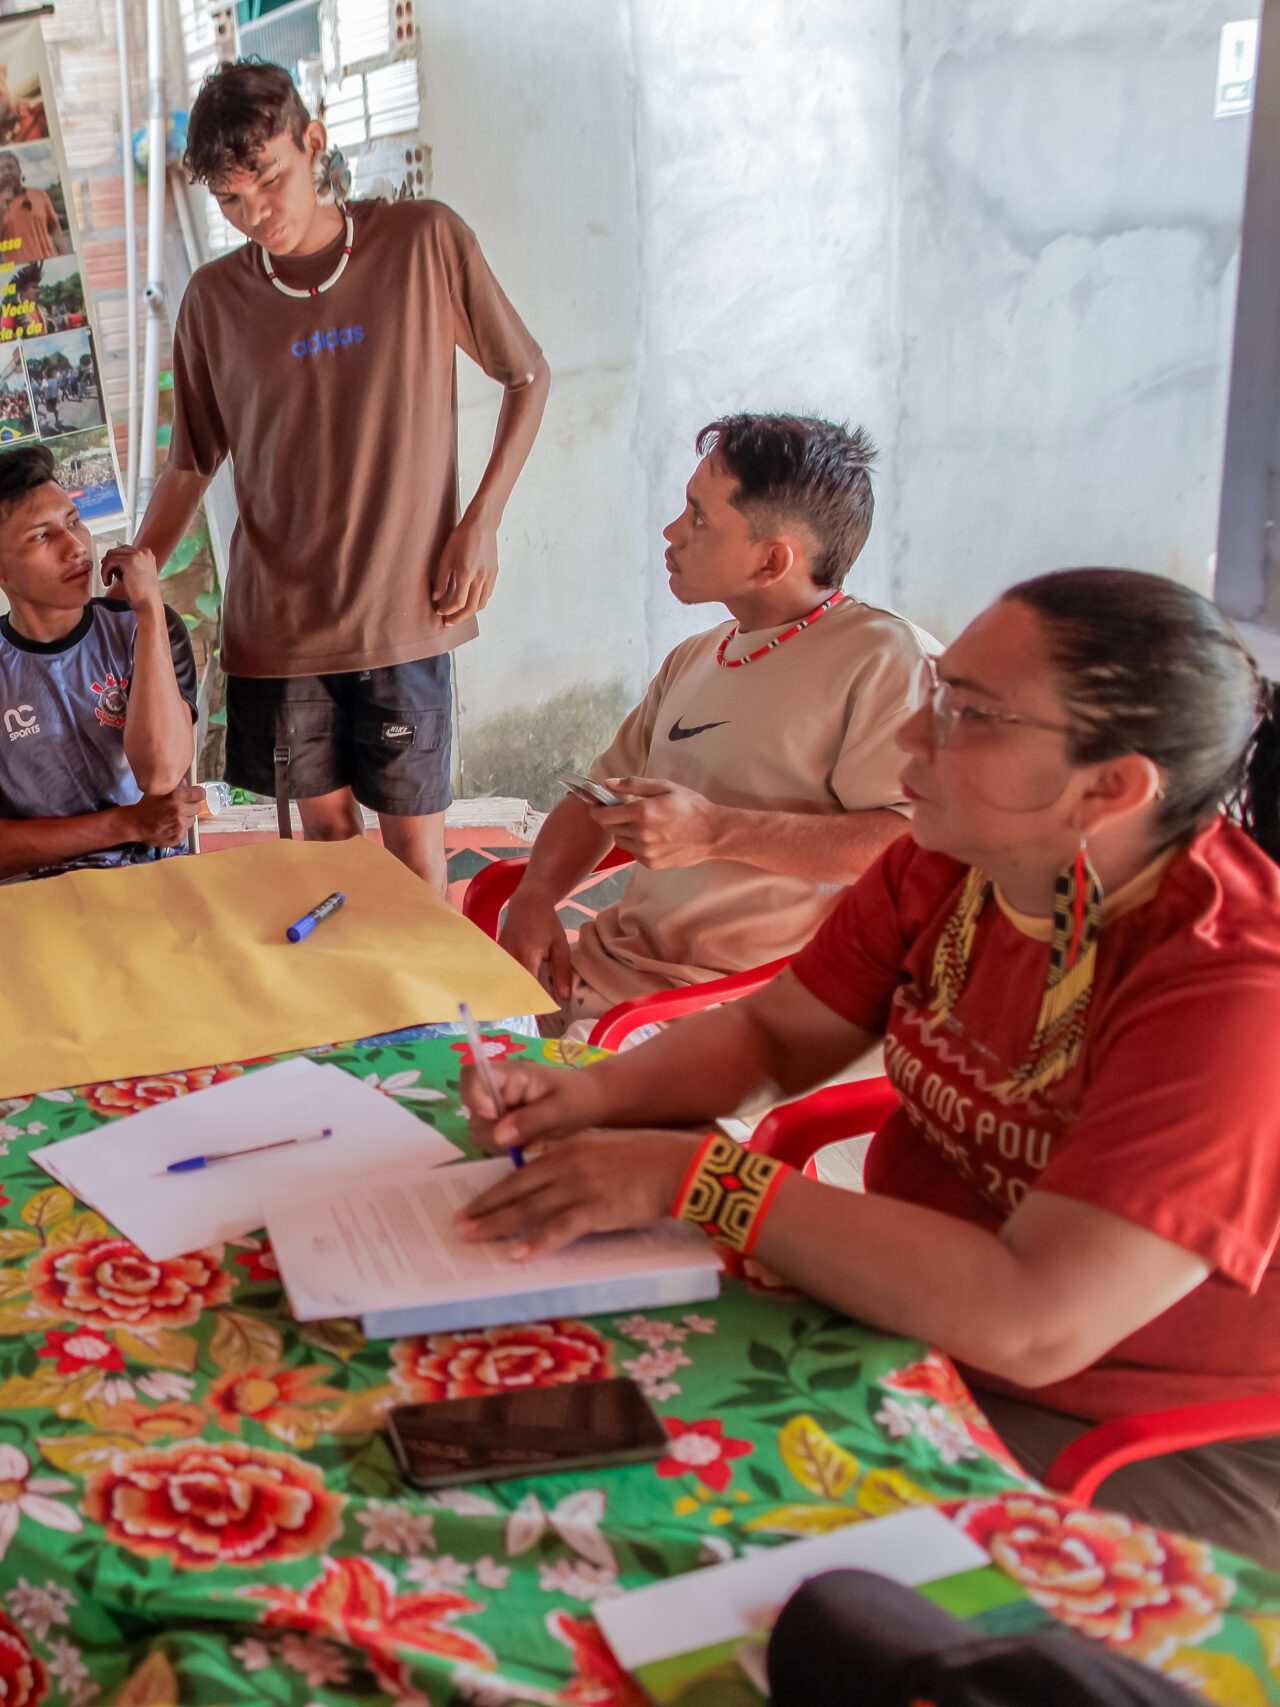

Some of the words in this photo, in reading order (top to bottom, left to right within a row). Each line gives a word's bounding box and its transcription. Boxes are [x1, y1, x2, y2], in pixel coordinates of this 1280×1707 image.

[290, 325, 366, 360] adidas
[9, 723, 42, 742] SPORTS
[921, 1072, 973, 1134] DOS
